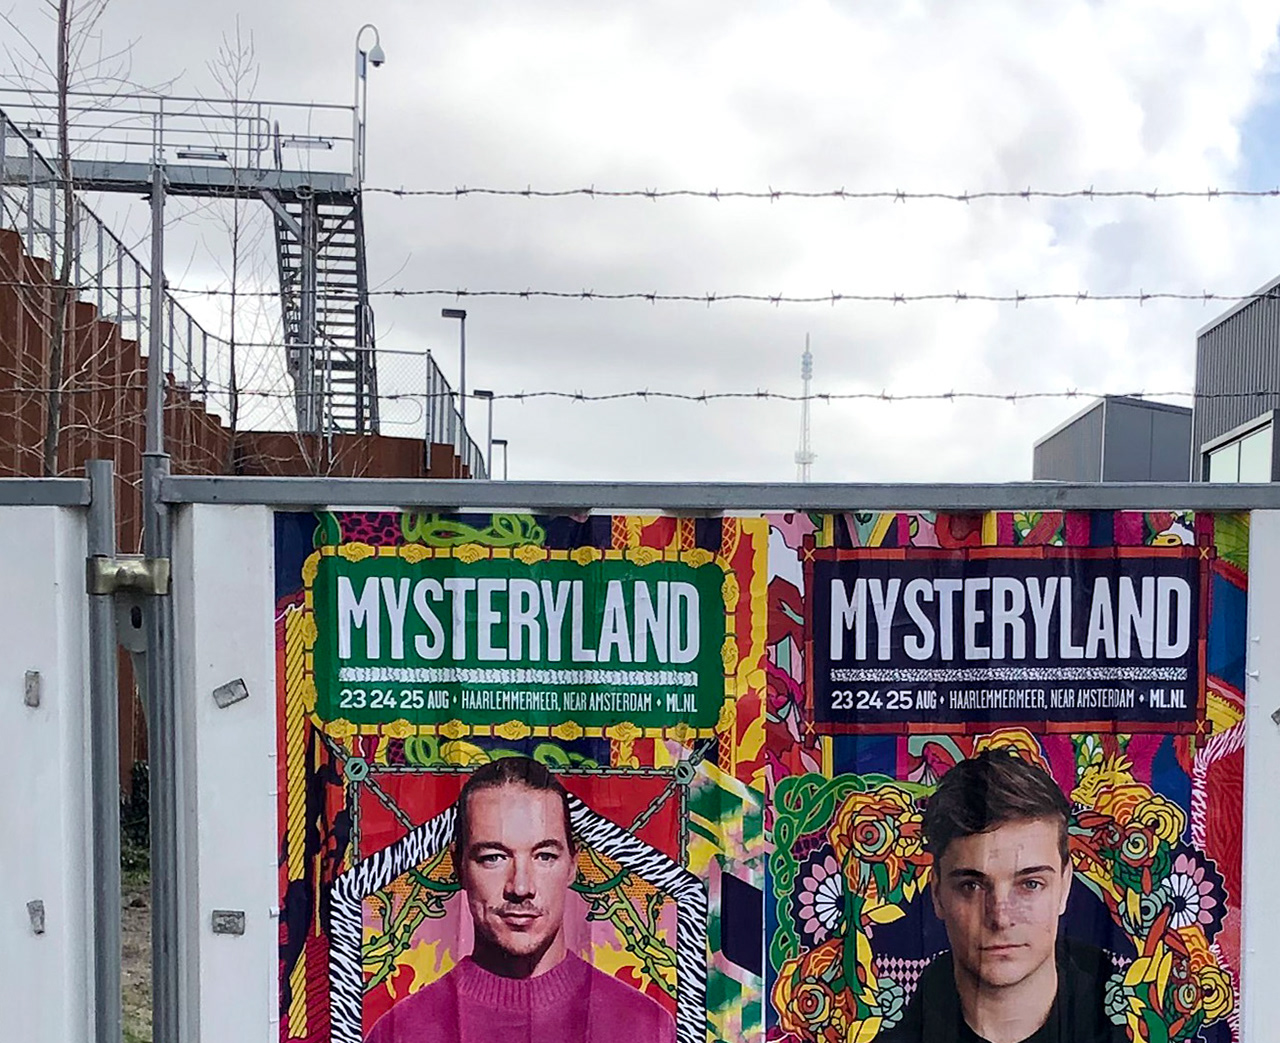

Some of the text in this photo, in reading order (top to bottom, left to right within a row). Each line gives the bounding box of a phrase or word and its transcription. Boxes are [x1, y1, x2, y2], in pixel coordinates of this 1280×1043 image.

[337, 576, 701, 663] MYSTERYLAND
[830, 576, 1191, 661] MYSTERYLAND
[339, 689, 698, 712] 23 24 25 AUG HAARLEMMERMEER, NEAR AMSTERDAM ML.NL
[831, 688, 1187, 710] 23 24 25 AUG HAARLEMMERMEER, NEAR AMSTERDAM ML.NL
